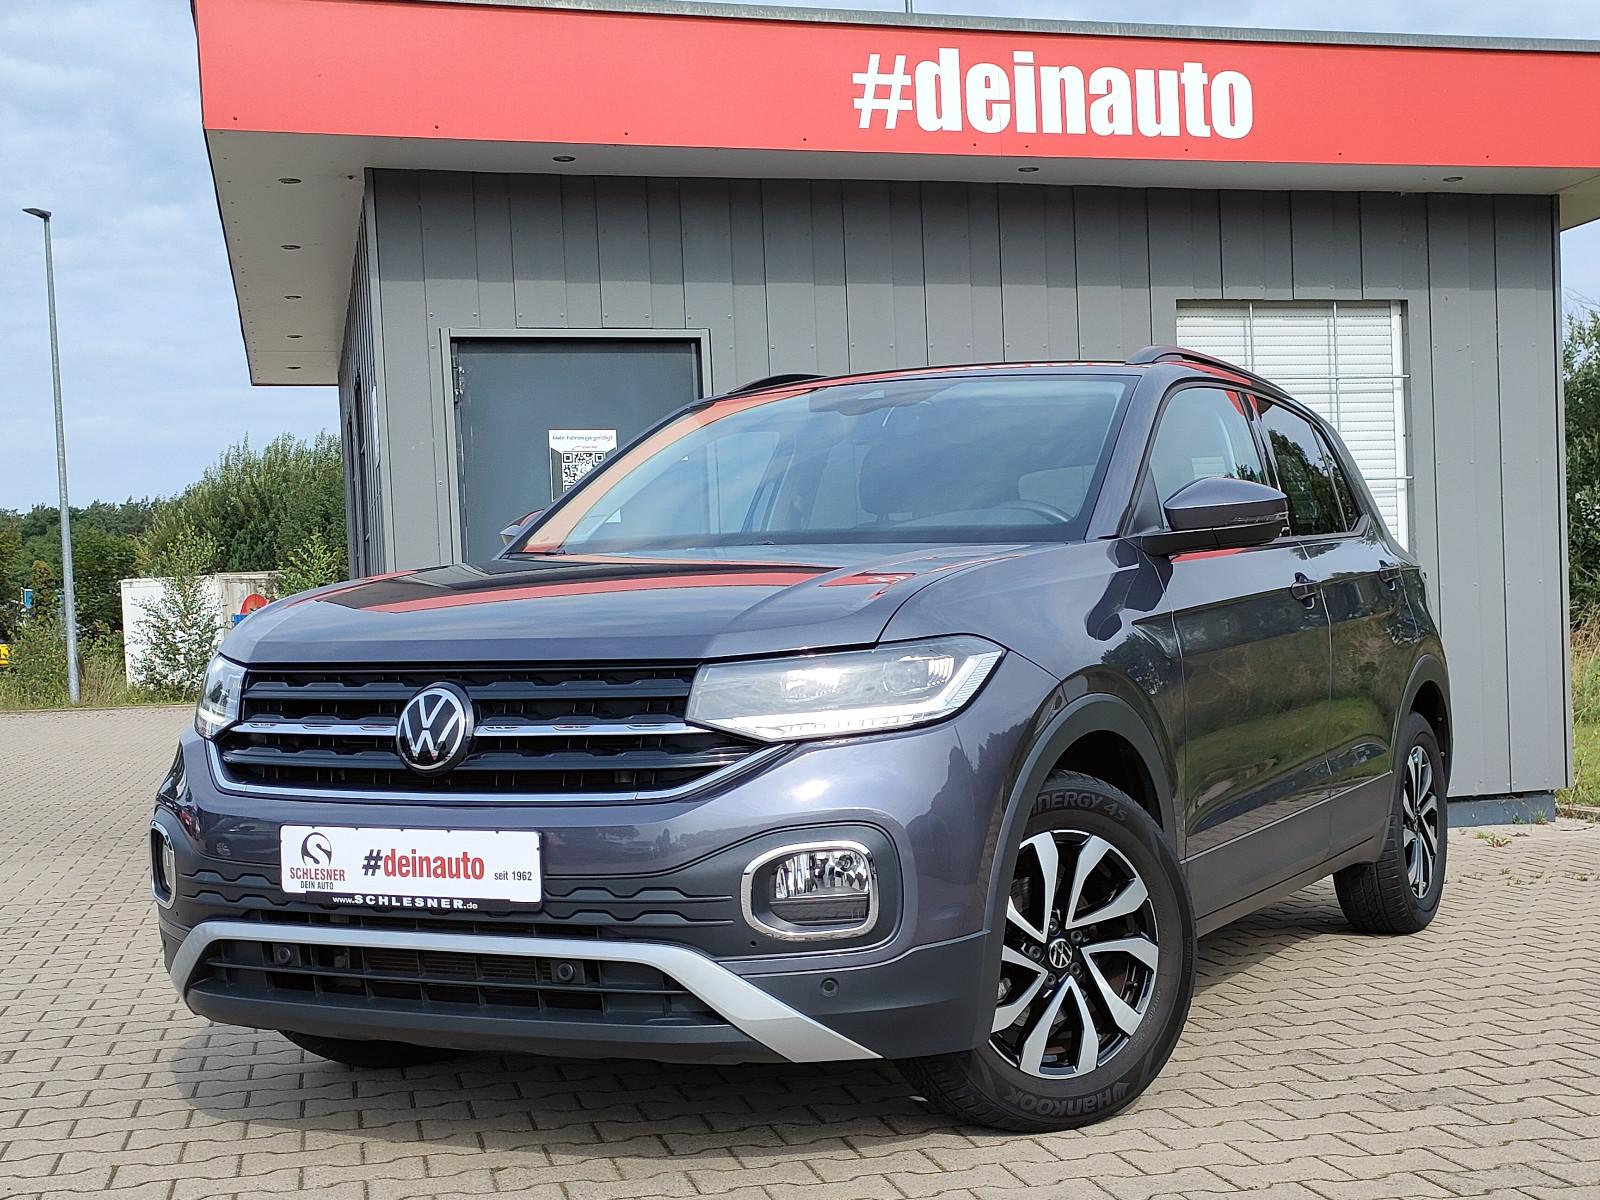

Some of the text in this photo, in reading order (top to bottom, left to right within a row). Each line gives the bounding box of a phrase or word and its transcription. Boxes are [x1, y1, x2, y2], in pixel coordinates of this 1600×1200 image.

[851, 47, 1253, 140] #deinauto
[361, 848, 485, 880] #deinauto
[289, 867, 346, 882] SCHLESNER
[494, 870, 533, 881] seit 1962
[300, 880, 334, 891] DEIN AUTO
[332, 894, 478, 910] www.SCHLESNER.de
